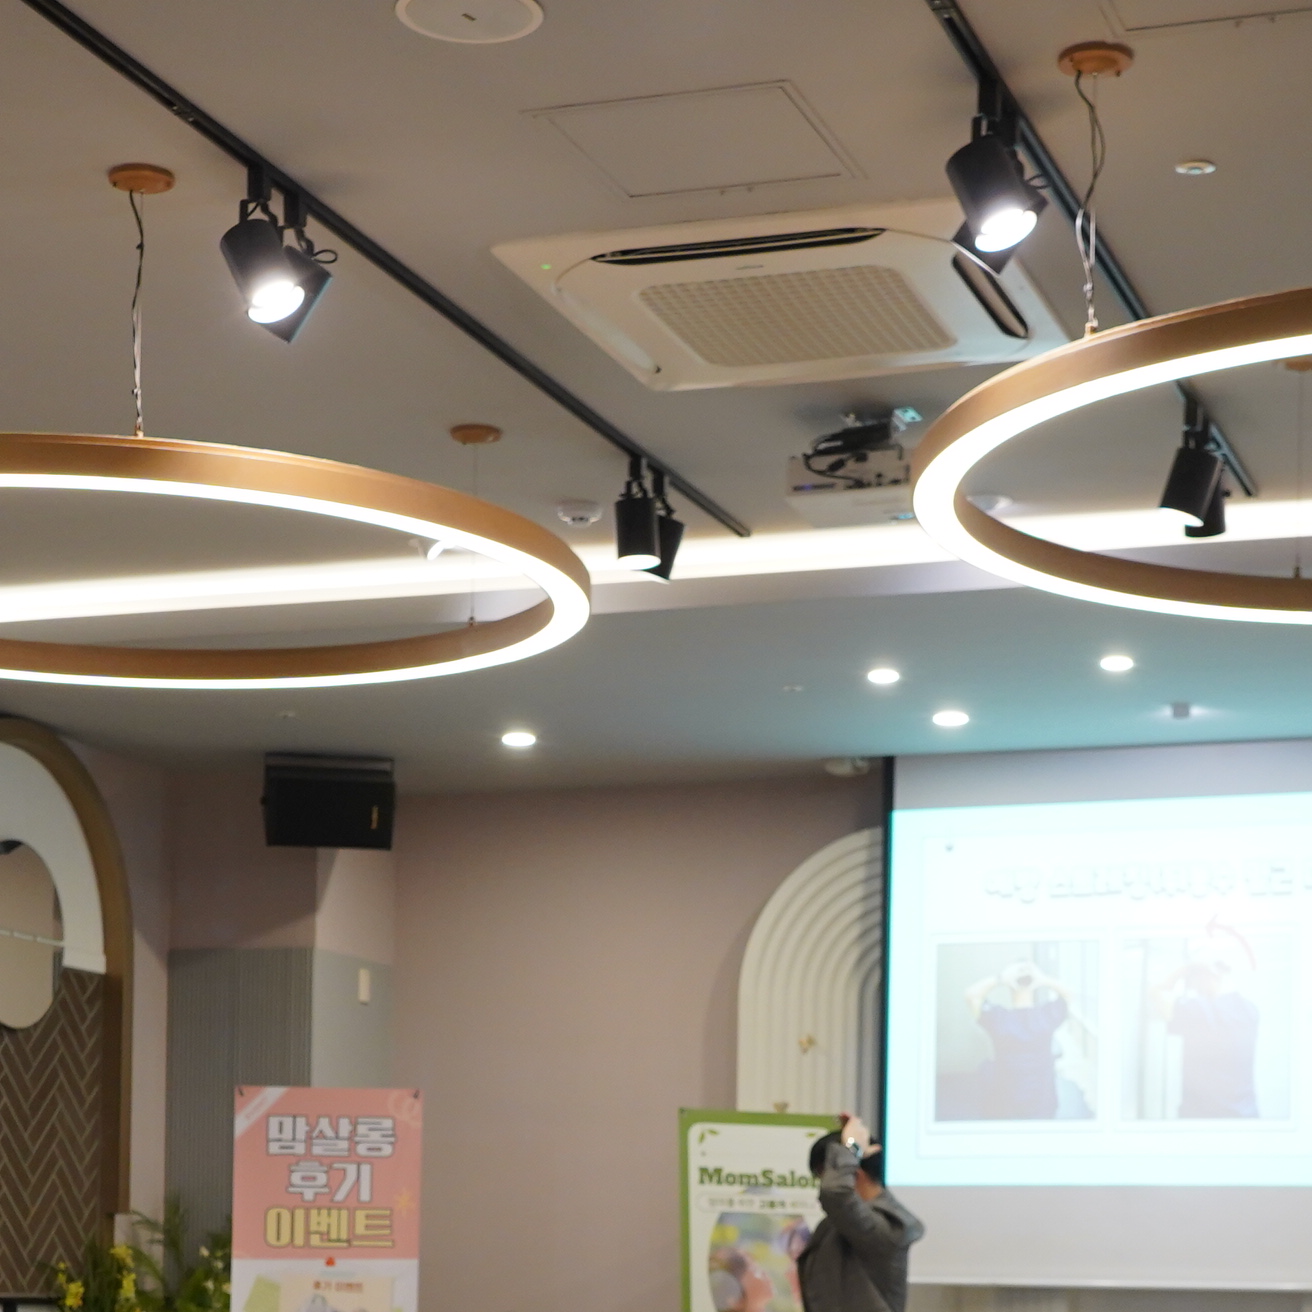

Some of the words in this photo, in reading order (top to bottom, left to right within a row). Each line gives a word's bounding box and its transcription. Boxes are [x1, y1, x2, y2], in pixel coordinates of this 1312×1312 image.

[266, 1115, 395, 1158] 맘살롱
[287, 1159, 372, 1203] 후기
[265, 1206, 394, 1248] 이벤트
